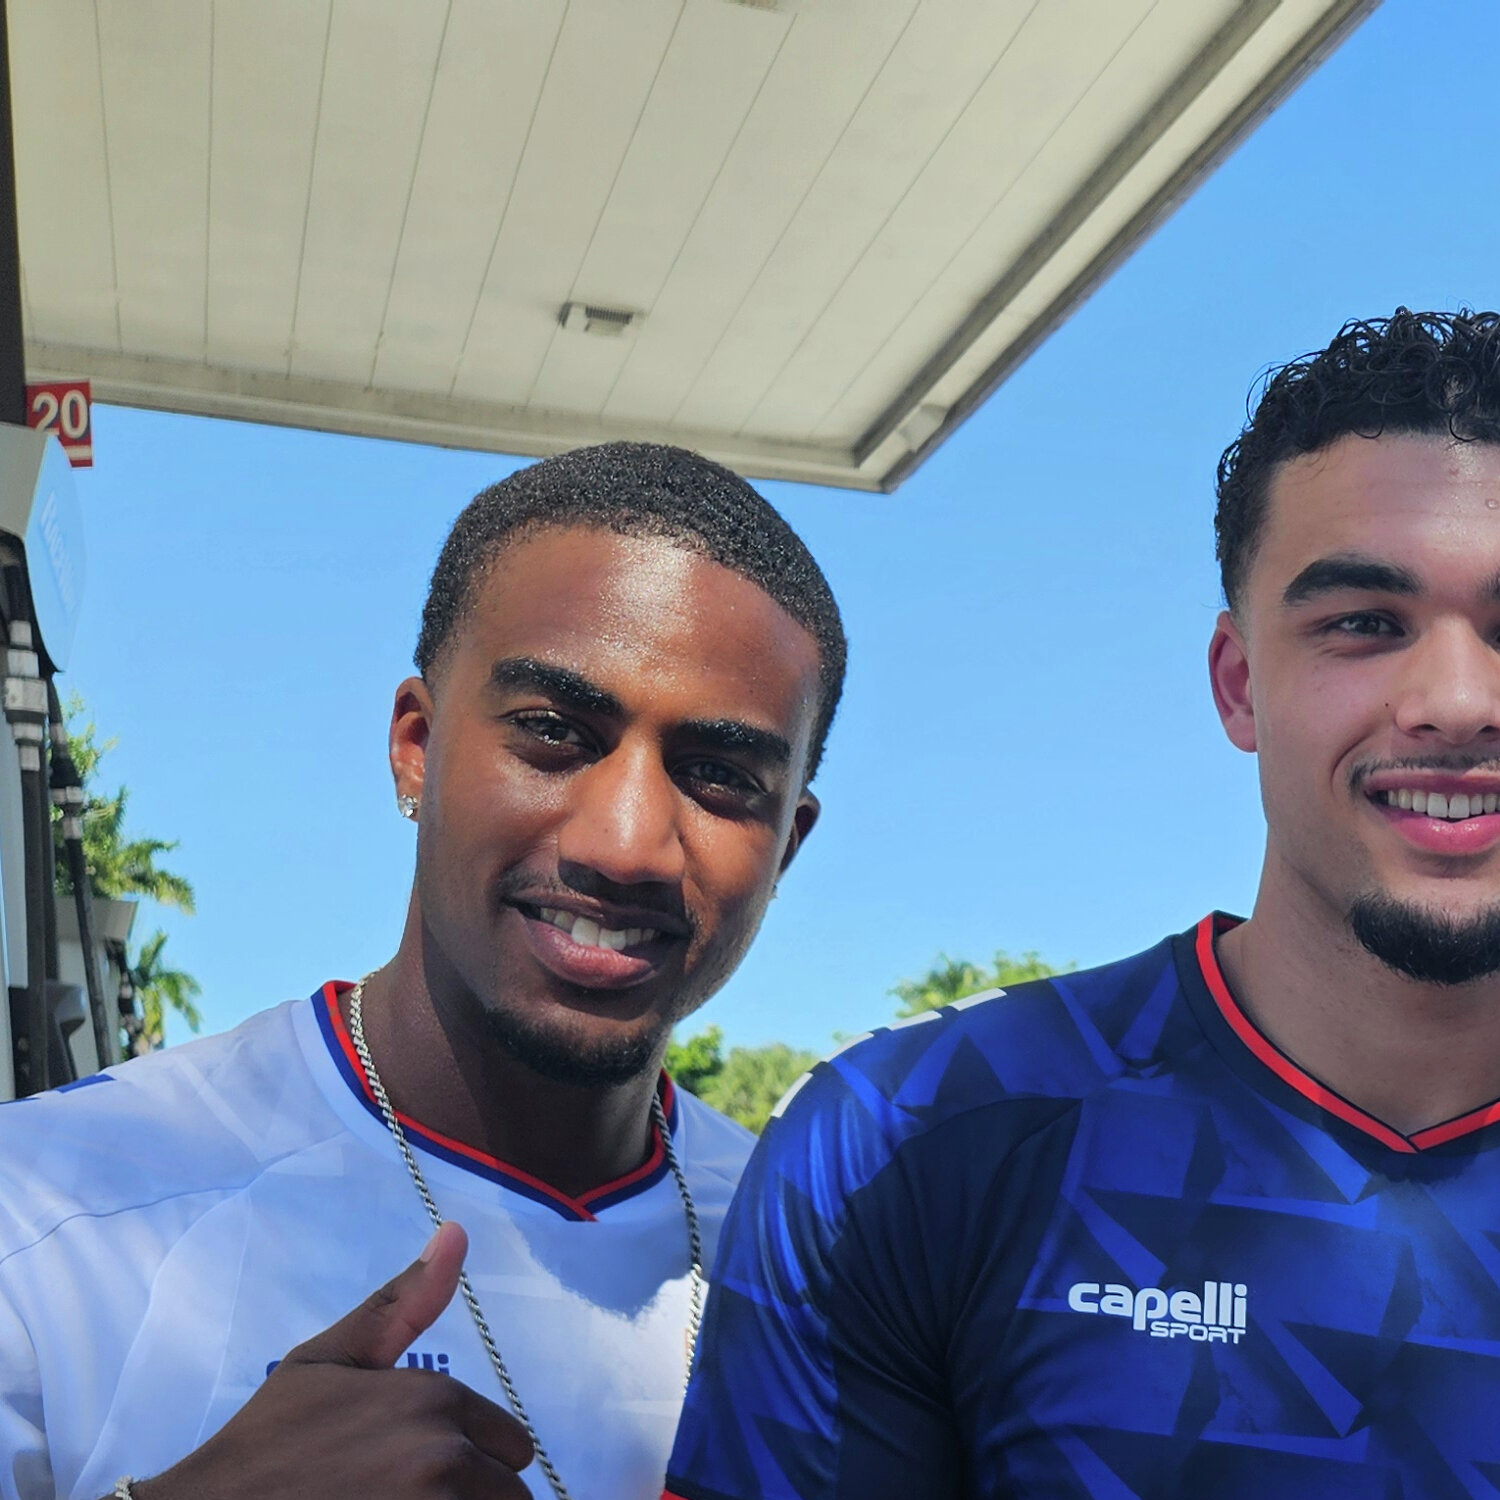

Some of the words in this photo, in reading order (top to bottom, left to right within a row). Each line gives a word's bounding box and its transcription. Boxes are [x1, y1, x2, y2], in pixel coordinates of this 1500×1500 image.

[32, 389, 90, 440] 20
[1067, 1280, 1248, 1331] capelli
[1150, 1321, 1247, 1344] SPORT
